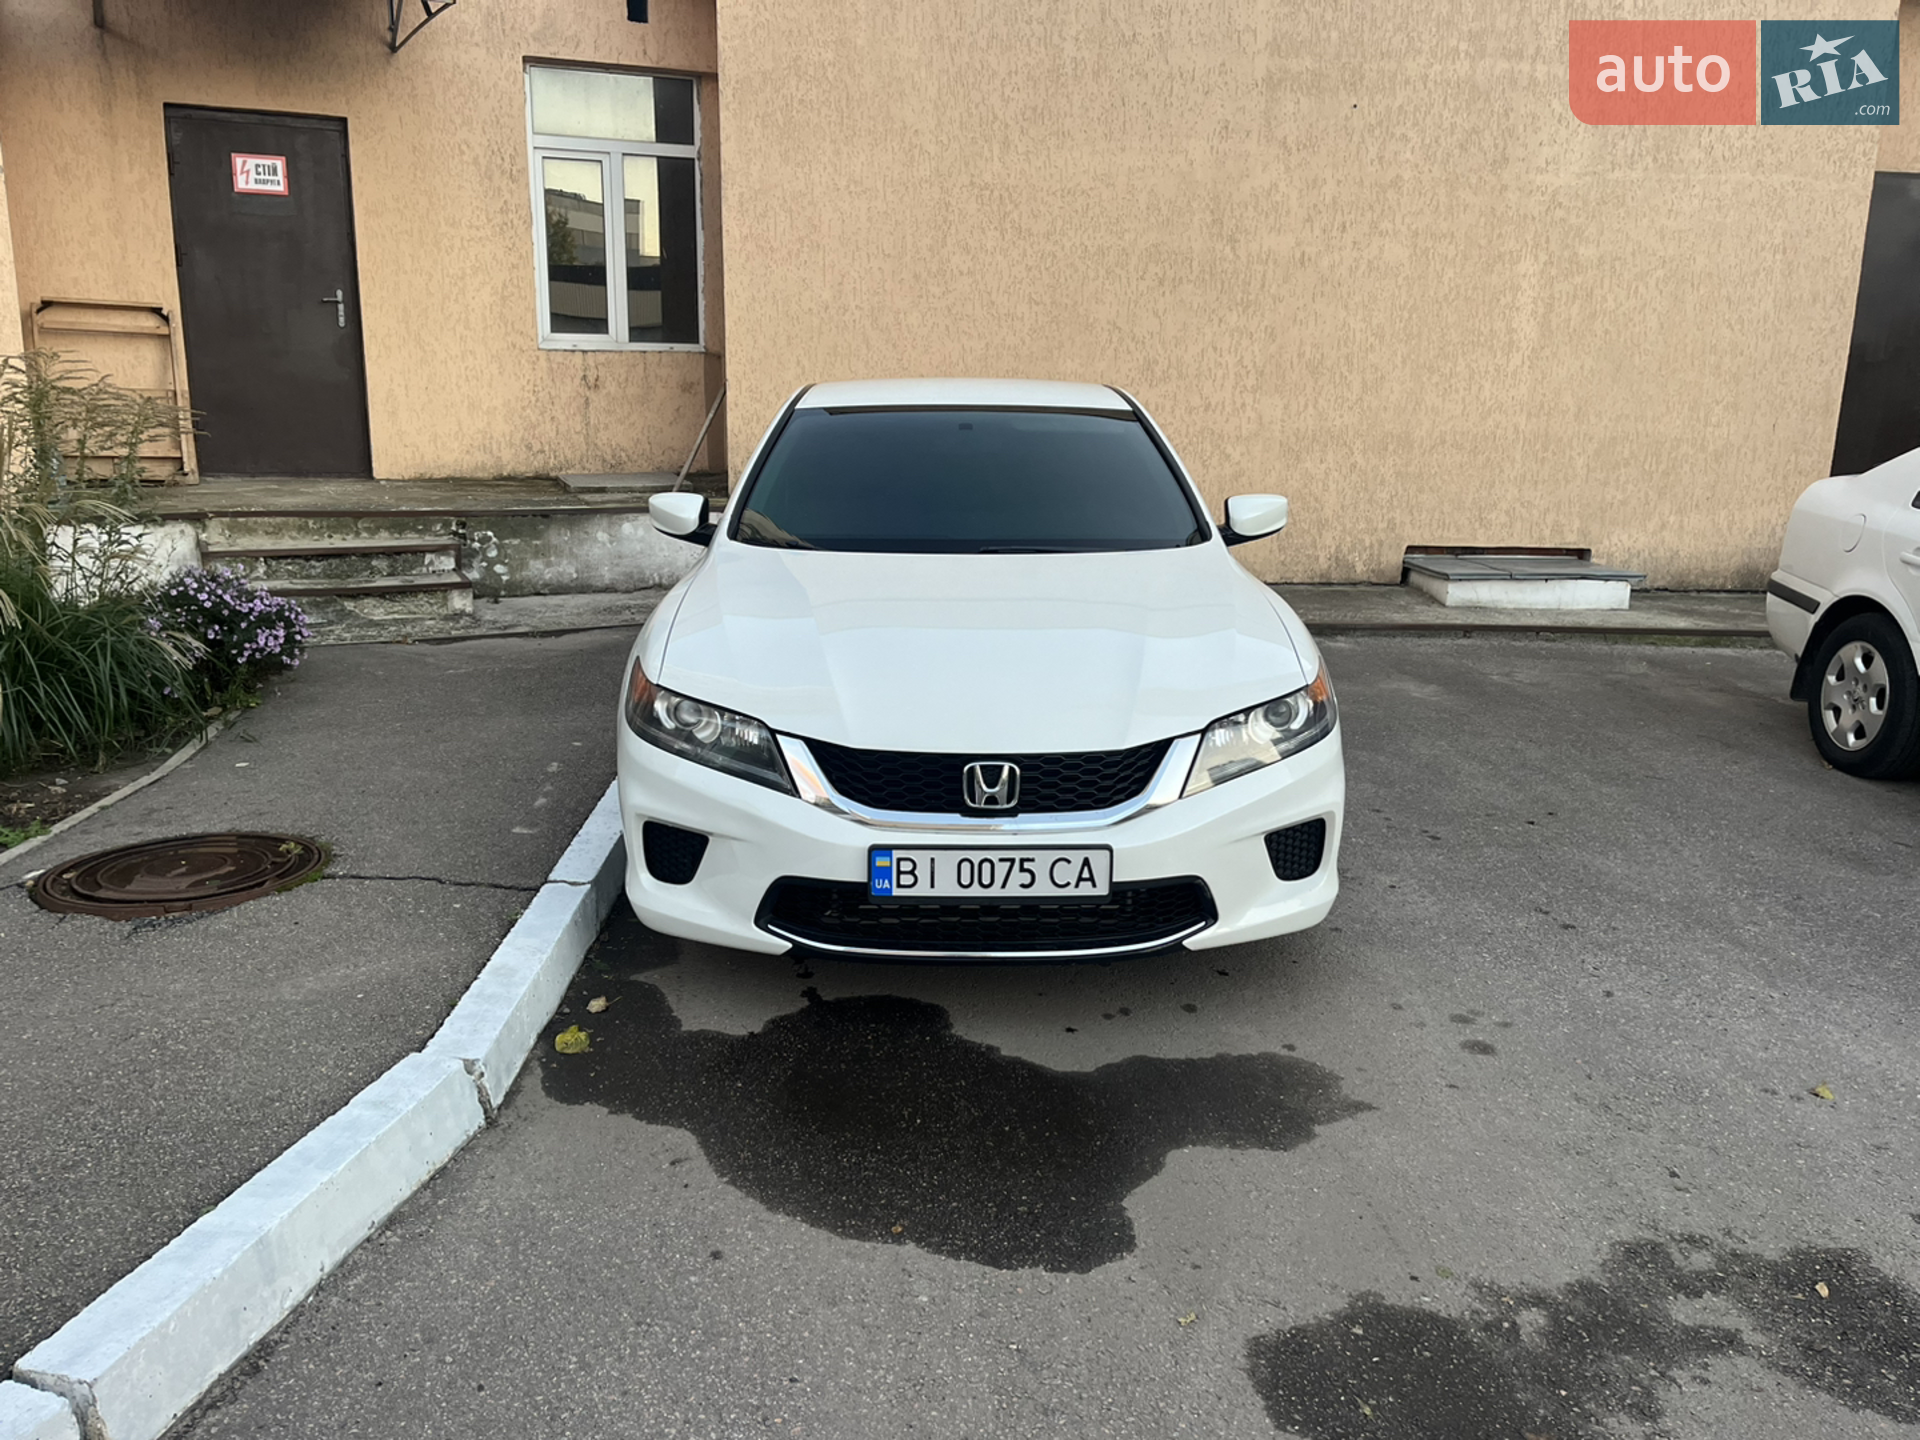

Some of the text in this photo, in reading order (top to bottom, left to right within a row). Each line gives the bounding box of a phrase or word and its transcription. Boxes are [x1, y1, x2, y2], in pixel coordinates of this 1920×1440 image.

[255, 162, 278, 177] СТІЙ
[896, 856, 1098, 890] BI 0075 CA
[875, 879, 891, 889] UA
